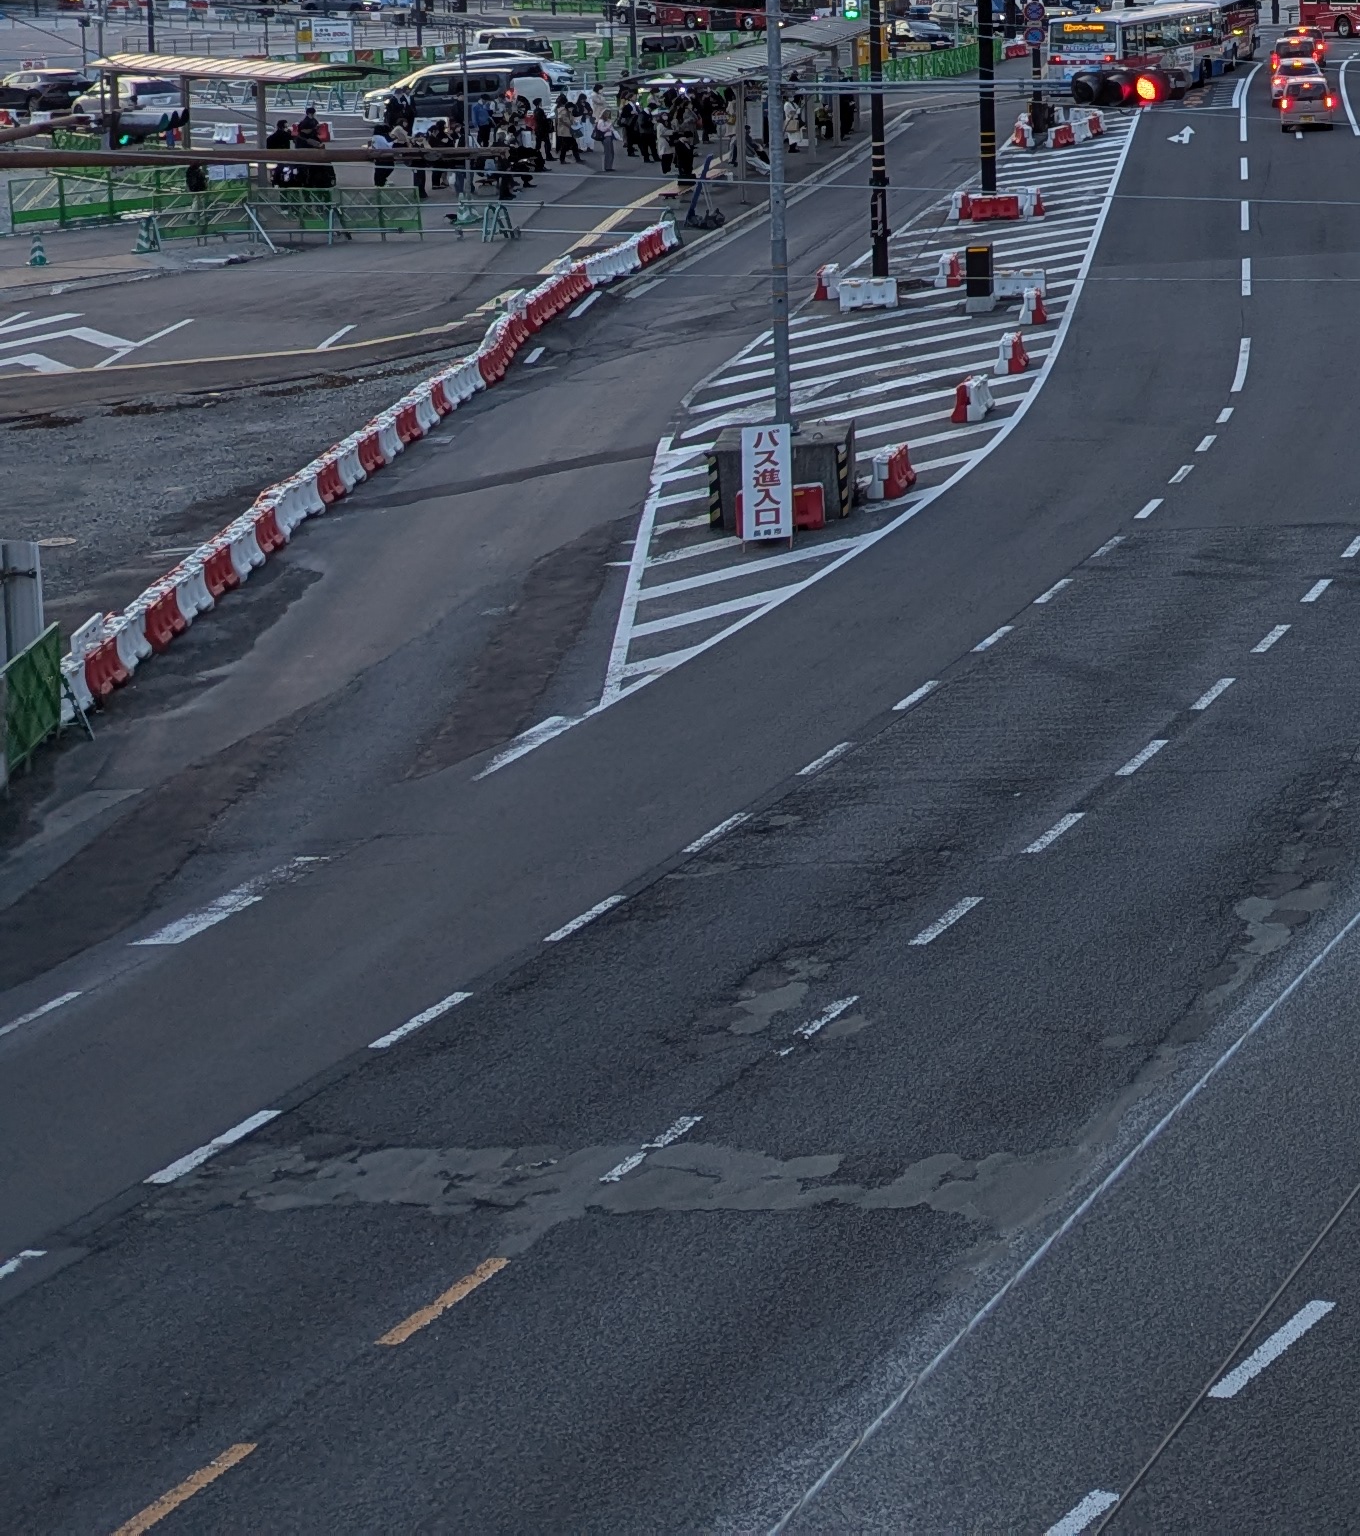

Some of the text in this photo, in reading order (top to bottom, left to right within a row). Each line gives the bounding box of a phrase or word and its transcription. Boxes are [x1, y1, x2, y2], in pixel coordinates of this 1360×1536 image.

[753, 428, 782, 527] バス進入口
